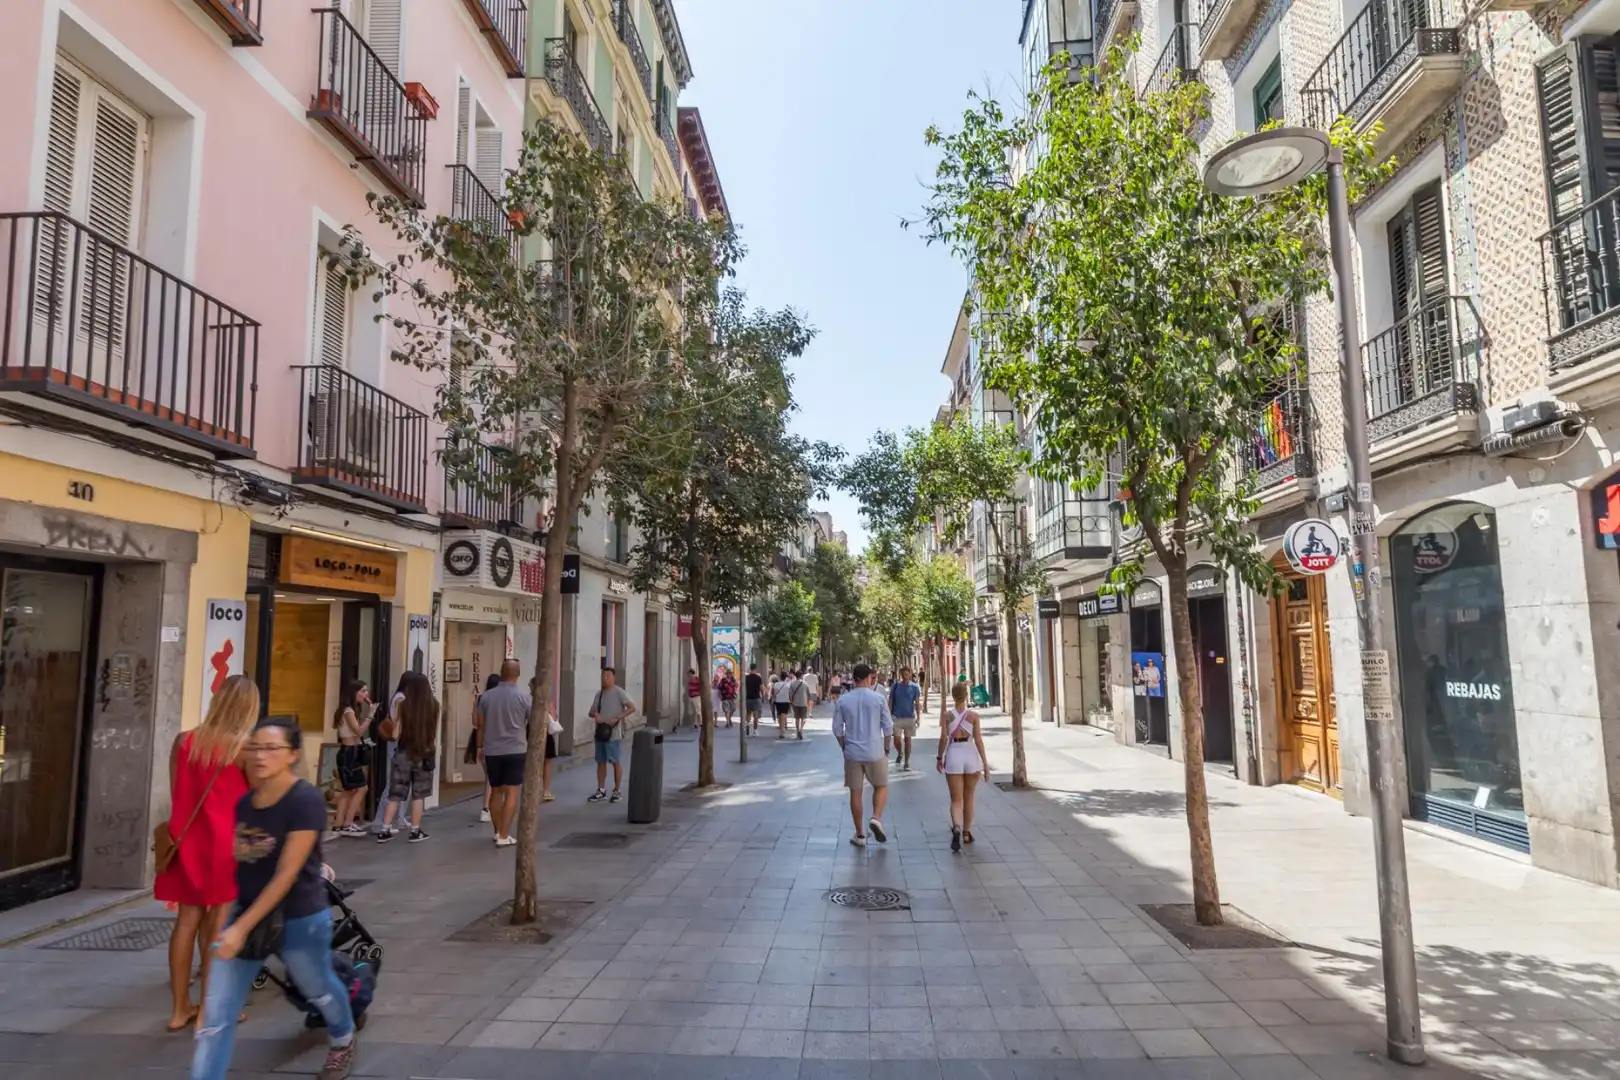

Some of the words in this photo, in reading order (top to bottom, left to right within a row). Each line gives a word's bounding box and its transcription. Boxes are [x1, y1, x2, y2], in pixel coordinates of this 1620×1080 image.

[68, 481, 94, 502] 10
[1308, 558, 1330, 567] JOTT
[210, 602, 243, 621] loco
[410, 617, 428, 631] polo
[1446, 681, 1501, 701] REBAJAS
